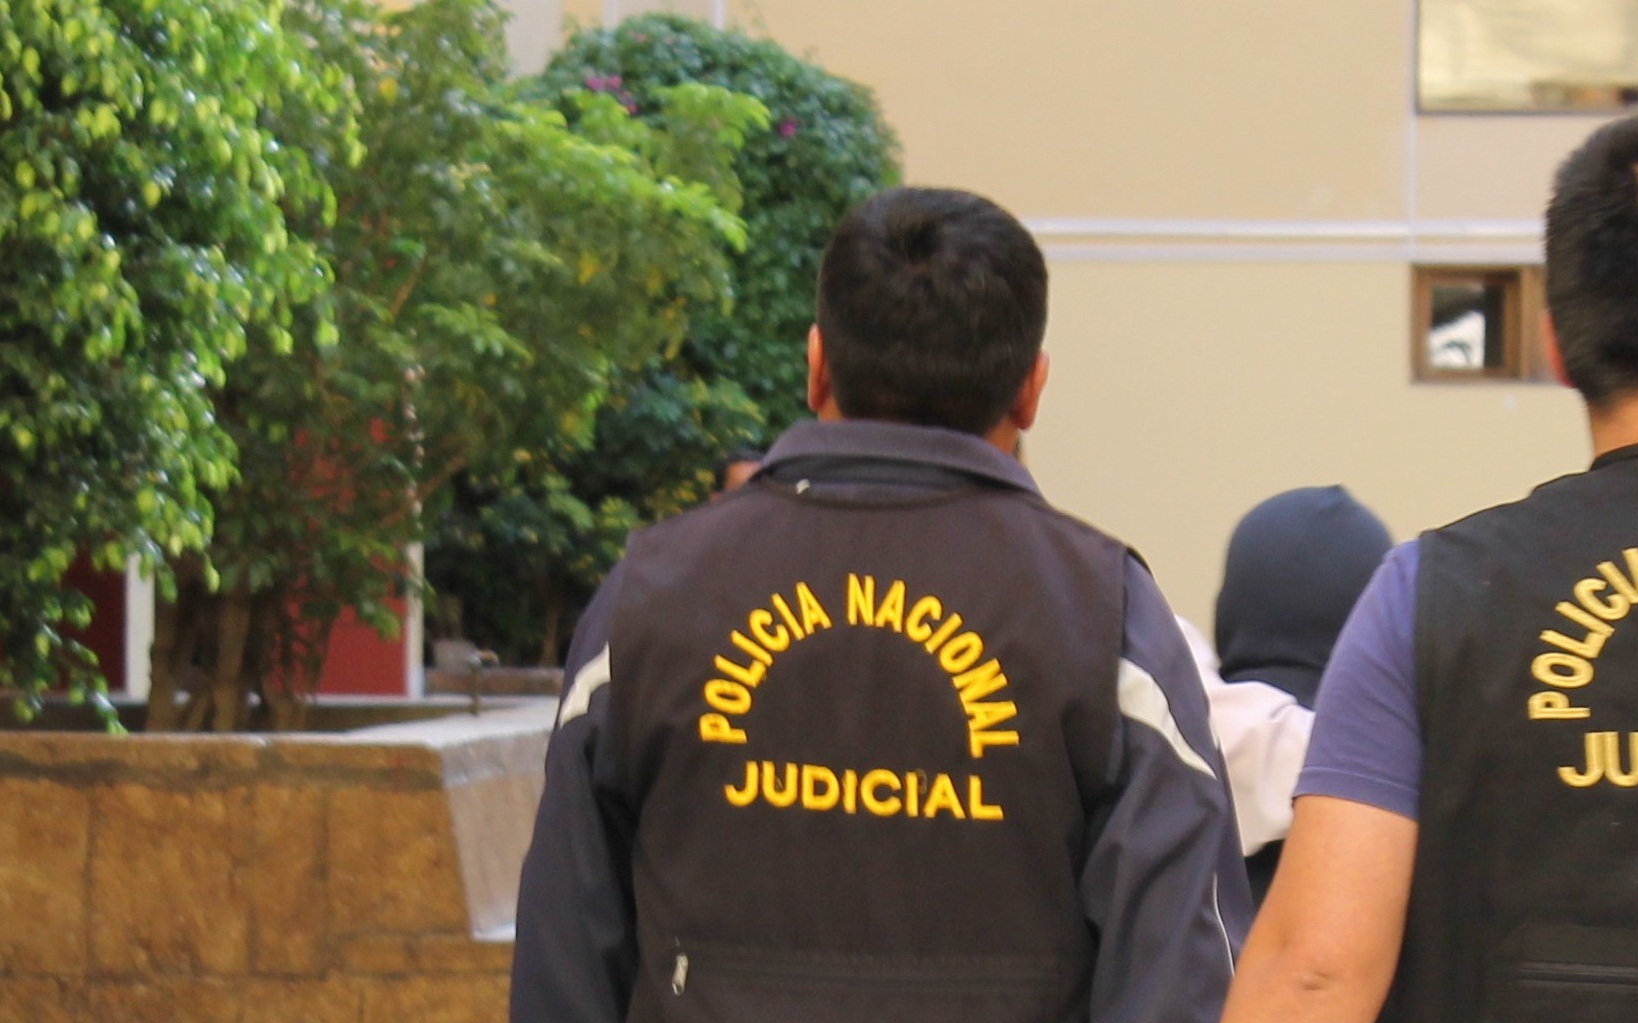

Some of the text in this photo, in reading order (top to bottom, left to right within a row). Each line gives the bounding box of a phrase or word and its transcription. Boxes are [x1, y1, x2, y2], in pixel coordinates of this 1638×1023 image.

[699, 572, 1020, 759] POLICIA NACIONAL
[724, 760, 1004, 821] JUDICIAL
